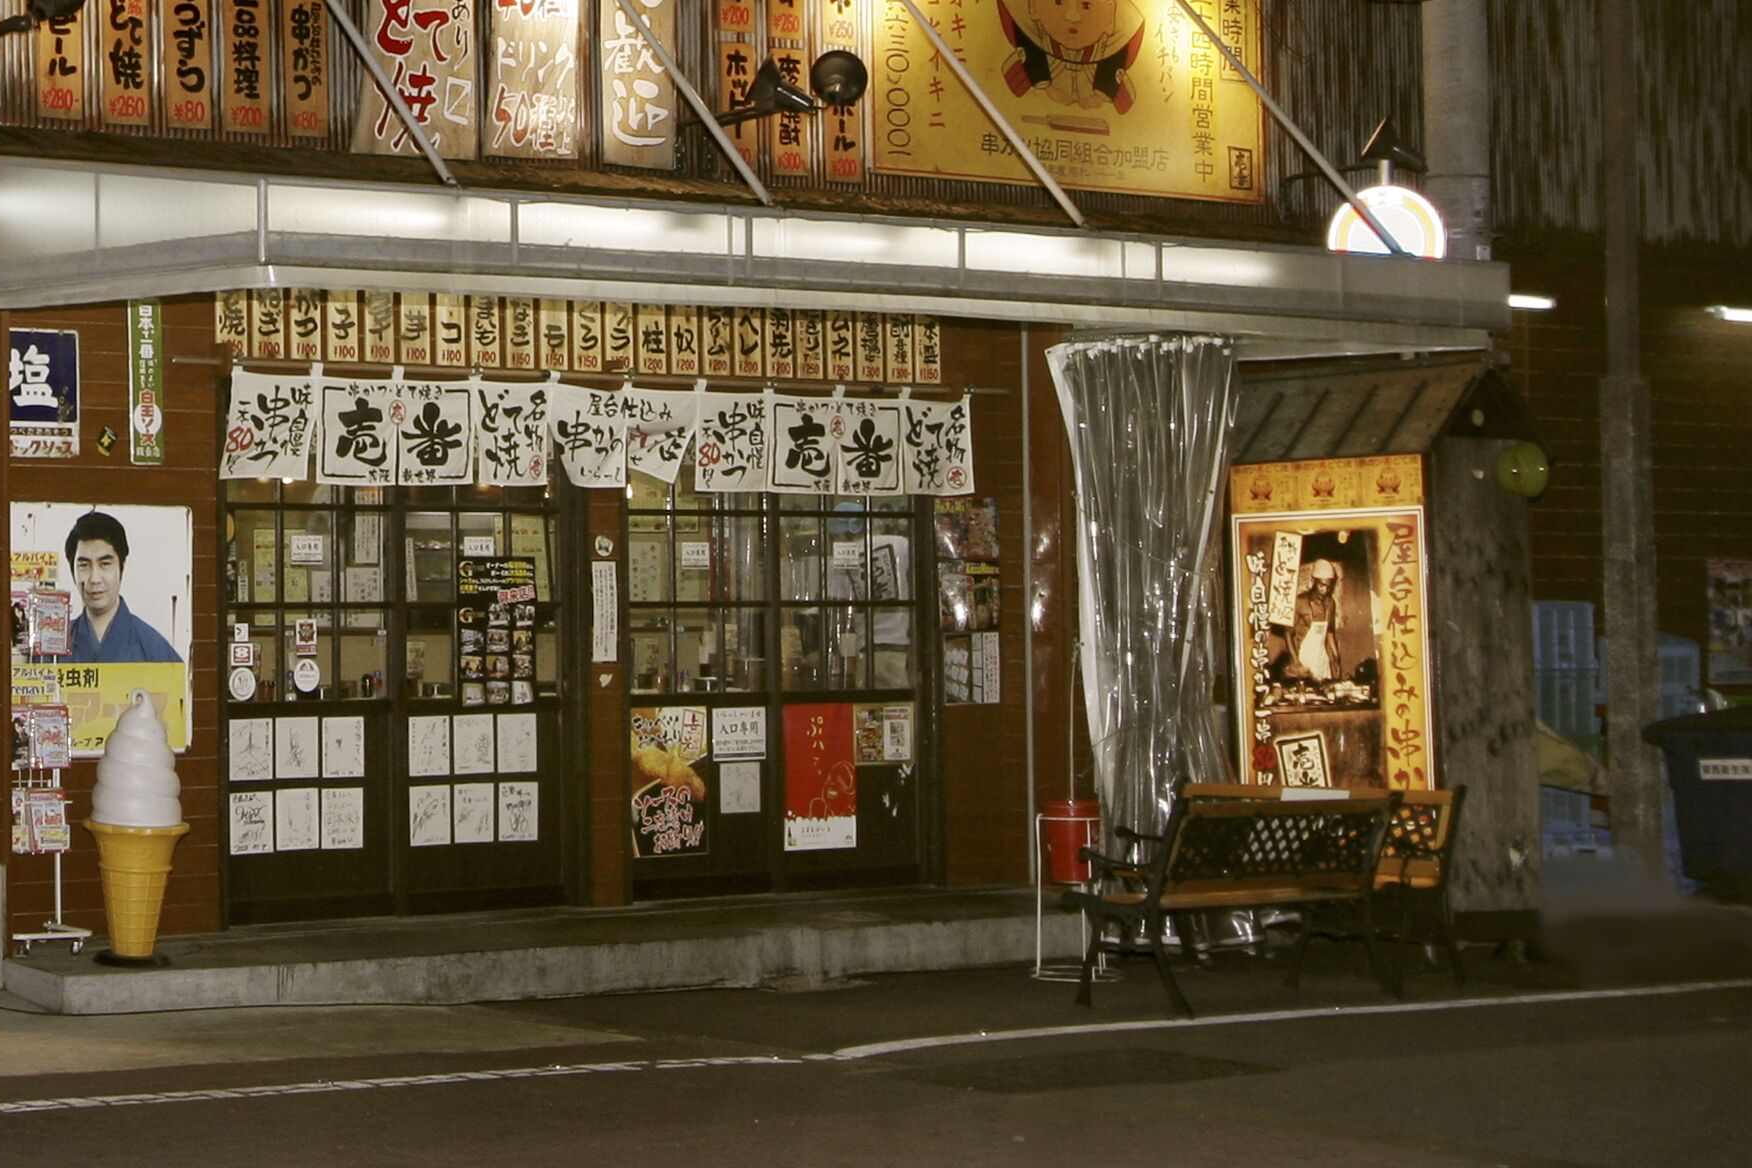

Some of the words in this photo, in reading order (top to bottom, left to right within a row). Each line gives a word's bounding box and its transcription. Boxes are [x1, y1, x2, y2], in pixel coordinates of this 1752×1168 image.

[772, 14, 801, 34] ¥250
[496, 38, 575, 88] ドリンク
[108, 96, 145, 118] ¥260
[173, 102, 206, 122] ¥80
[247, 385, 290, 470] 串かつ
[335, 397, 463, 467] 壱番
[477, 388, 529, 481] どて焼
[522, 389, 546, 453] 名物
[786, 414, 893, 481] 壱番
[905, 405, 946, 489] どて焼
